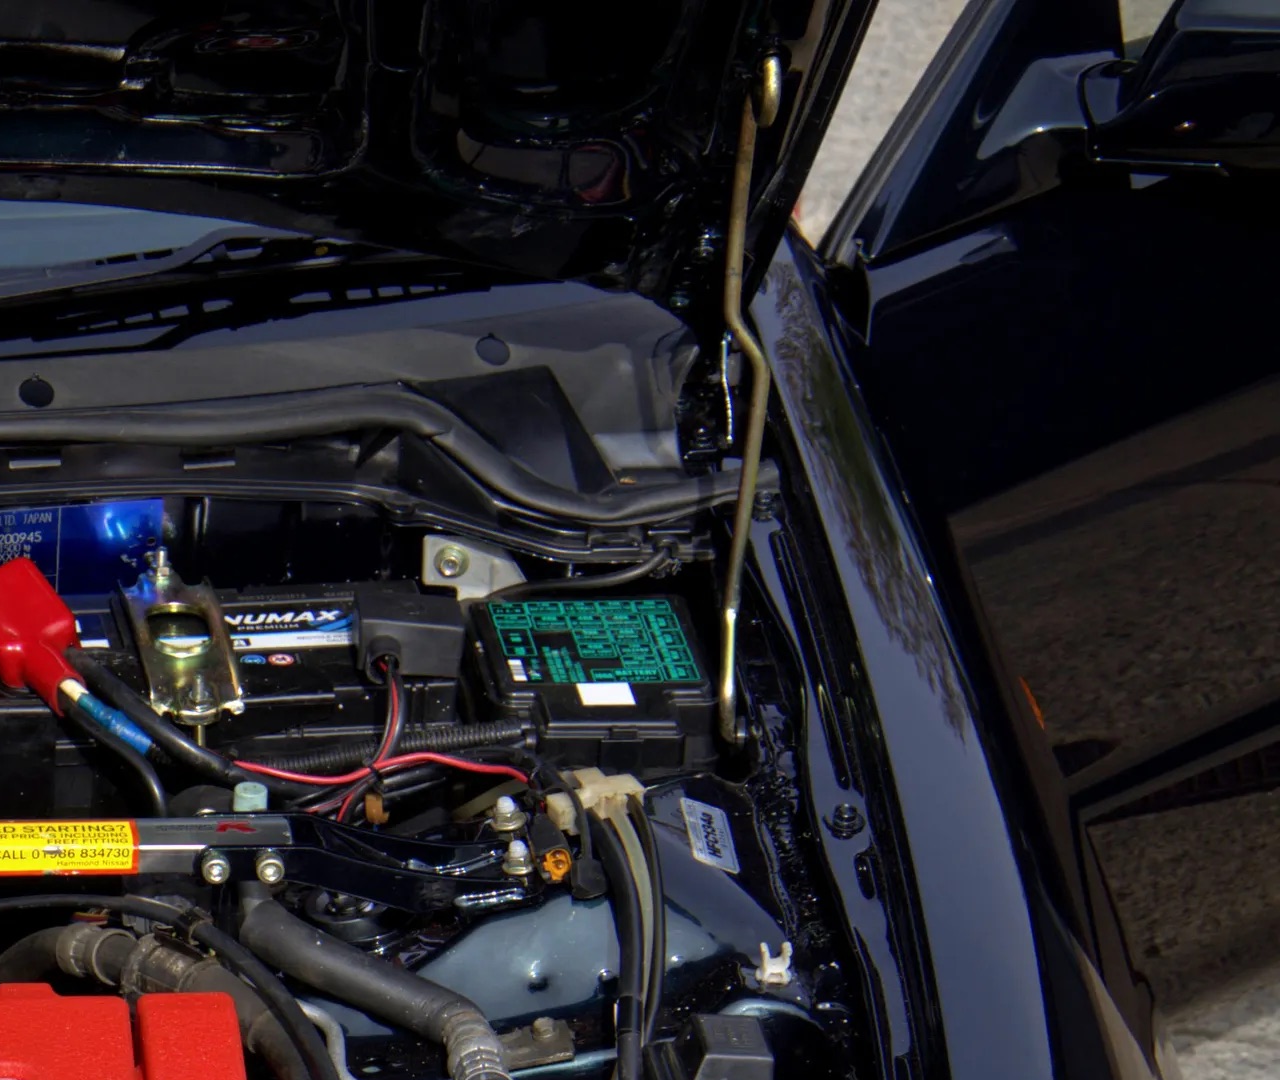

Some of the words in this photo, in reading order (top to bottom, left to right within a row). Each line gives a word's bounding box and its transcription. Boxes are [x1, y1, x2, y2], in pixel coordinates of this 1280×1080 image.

[23, 512, 52, 524] JAPAN
[224, 609, 342, 626] NUMAX
[237, 623, 300, 631] PREMIUM
[22, 825, 126, 833] STARTING?
[80, 848, 130, 858] 834730
